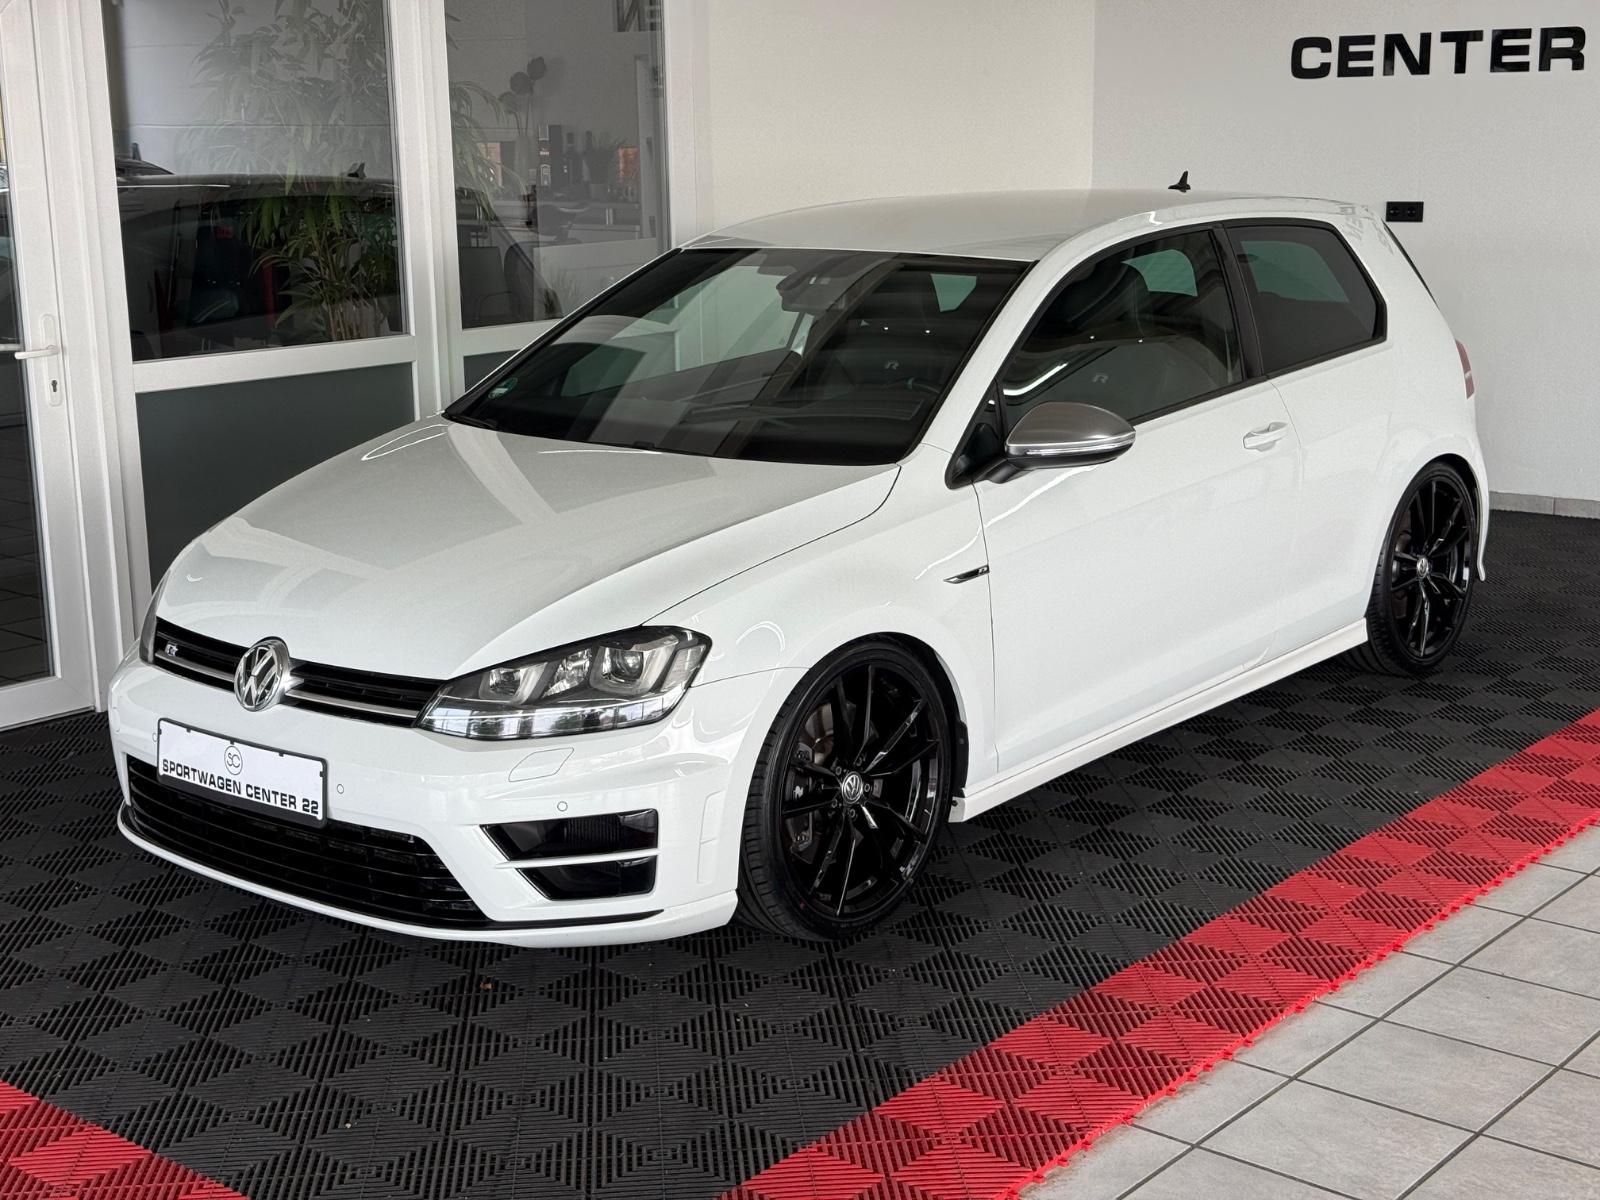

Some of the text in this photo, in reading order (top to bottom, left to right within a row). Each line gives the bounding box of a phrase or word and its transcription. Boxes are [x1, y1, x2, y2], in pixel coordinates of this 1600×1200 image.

[1291, 26, 1586, 79] CENTER
[162, 759, 319, 814] SPORTWAGEN CENTER 22
[226, 752, 241, 768] SC
